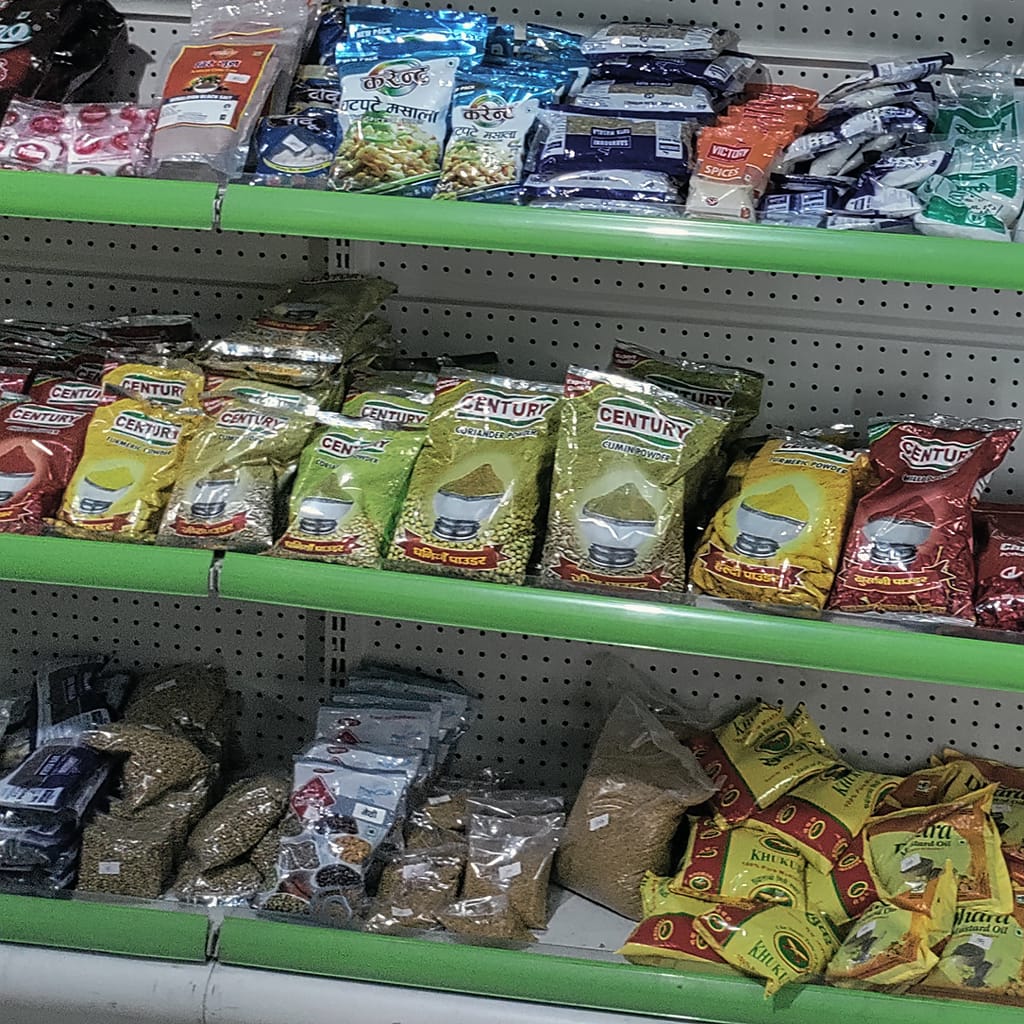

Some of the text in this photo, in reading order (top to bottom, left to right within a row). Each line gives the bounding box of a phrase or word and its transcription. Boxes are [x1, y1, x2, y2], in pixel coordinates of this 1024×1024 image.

[712, 145, 748, 160] VICTORY
[704, 164, 740, 178] SPICES
[461, 395, 552, 417] CENTURY
[12, 408, 78, 424] CENTURY
[220, 412, 282, 428] CENTURY
[362, 406, 426, 424] CENTURY
[600, 406, 690, 440] CENTURY
[115, 416, 179, 440] CENTURY
[455, 426, 506, 439] CORIANDER
[602, 440, 671, 462] CUMIN POWDER
